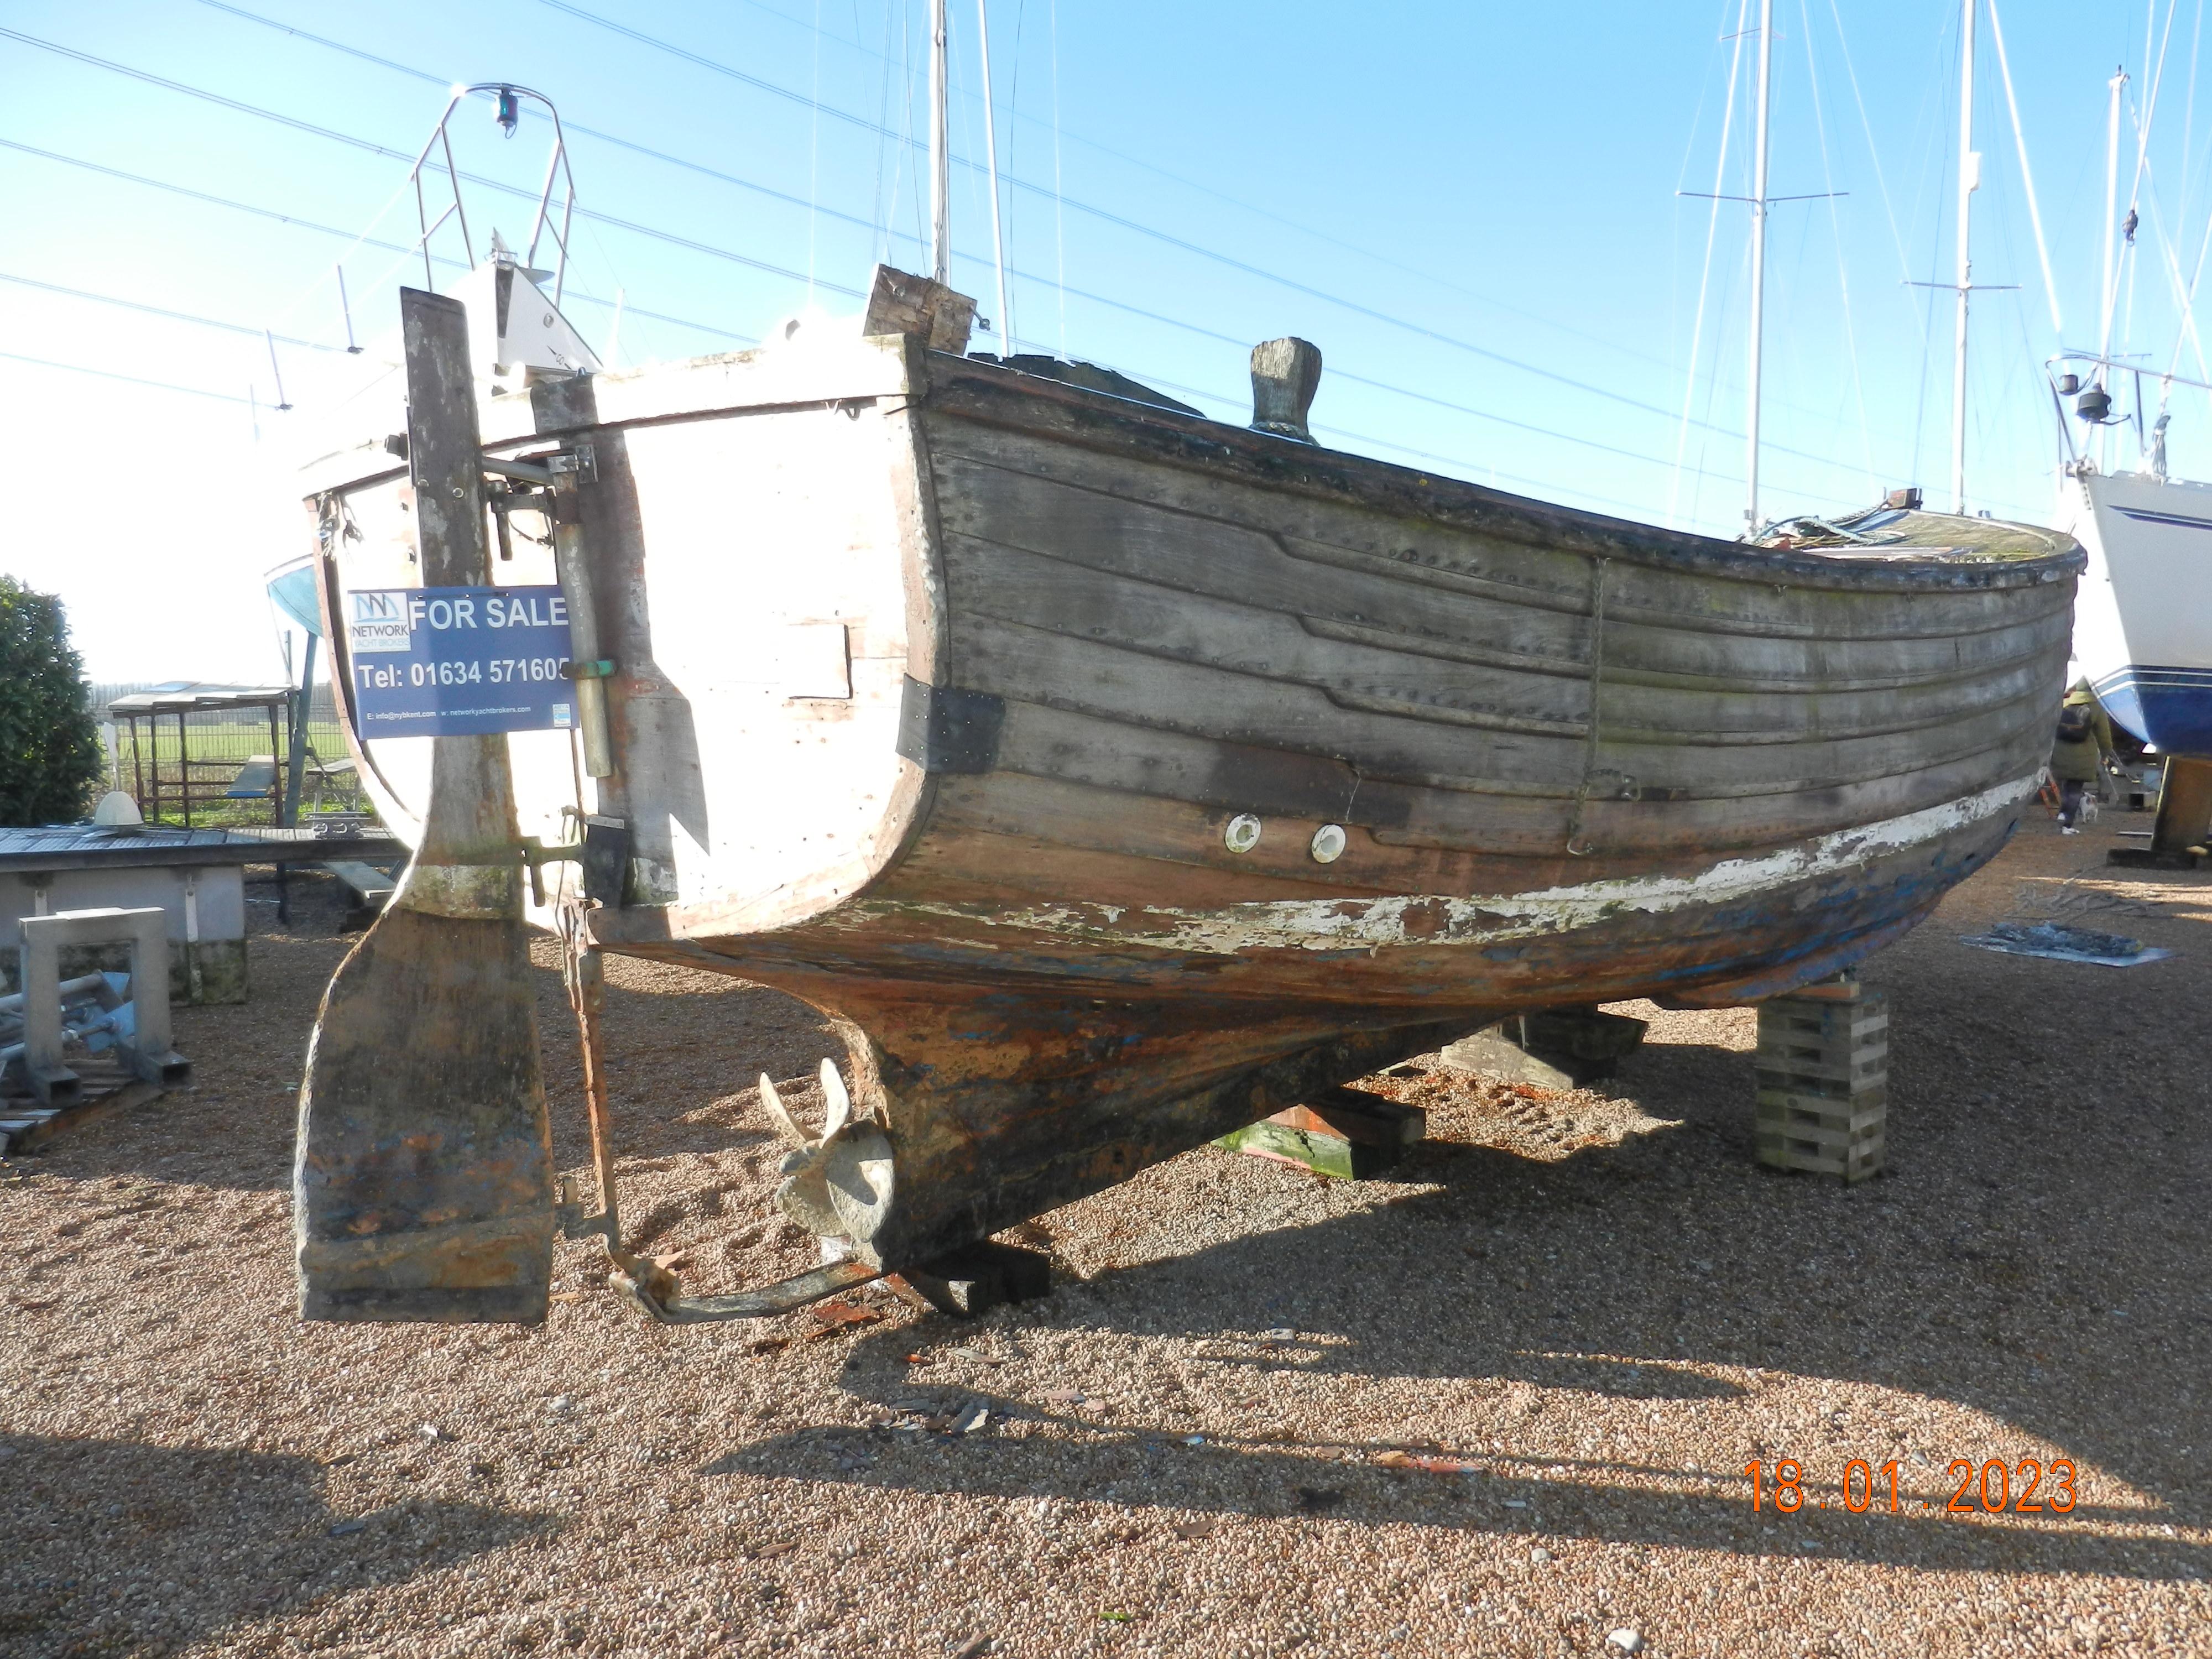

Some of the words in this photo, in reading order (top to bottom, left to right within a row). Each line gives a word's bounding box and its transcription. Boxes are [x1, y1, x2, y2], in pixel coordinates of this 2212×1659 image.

[409, 600, 477, 630] FOR
[487, 597, 569, 628] SALE
[353, 624, 409, 638] NETWORK
[379, 638, 411, 646] BROKERS
[358, 664, 403, 688] Tel:
[411, 660, 482, 686] 01634
[375, 711, 436, 721] info@nybkent.com
[450, 706, 531, 717] networkyachtbrokers.com
